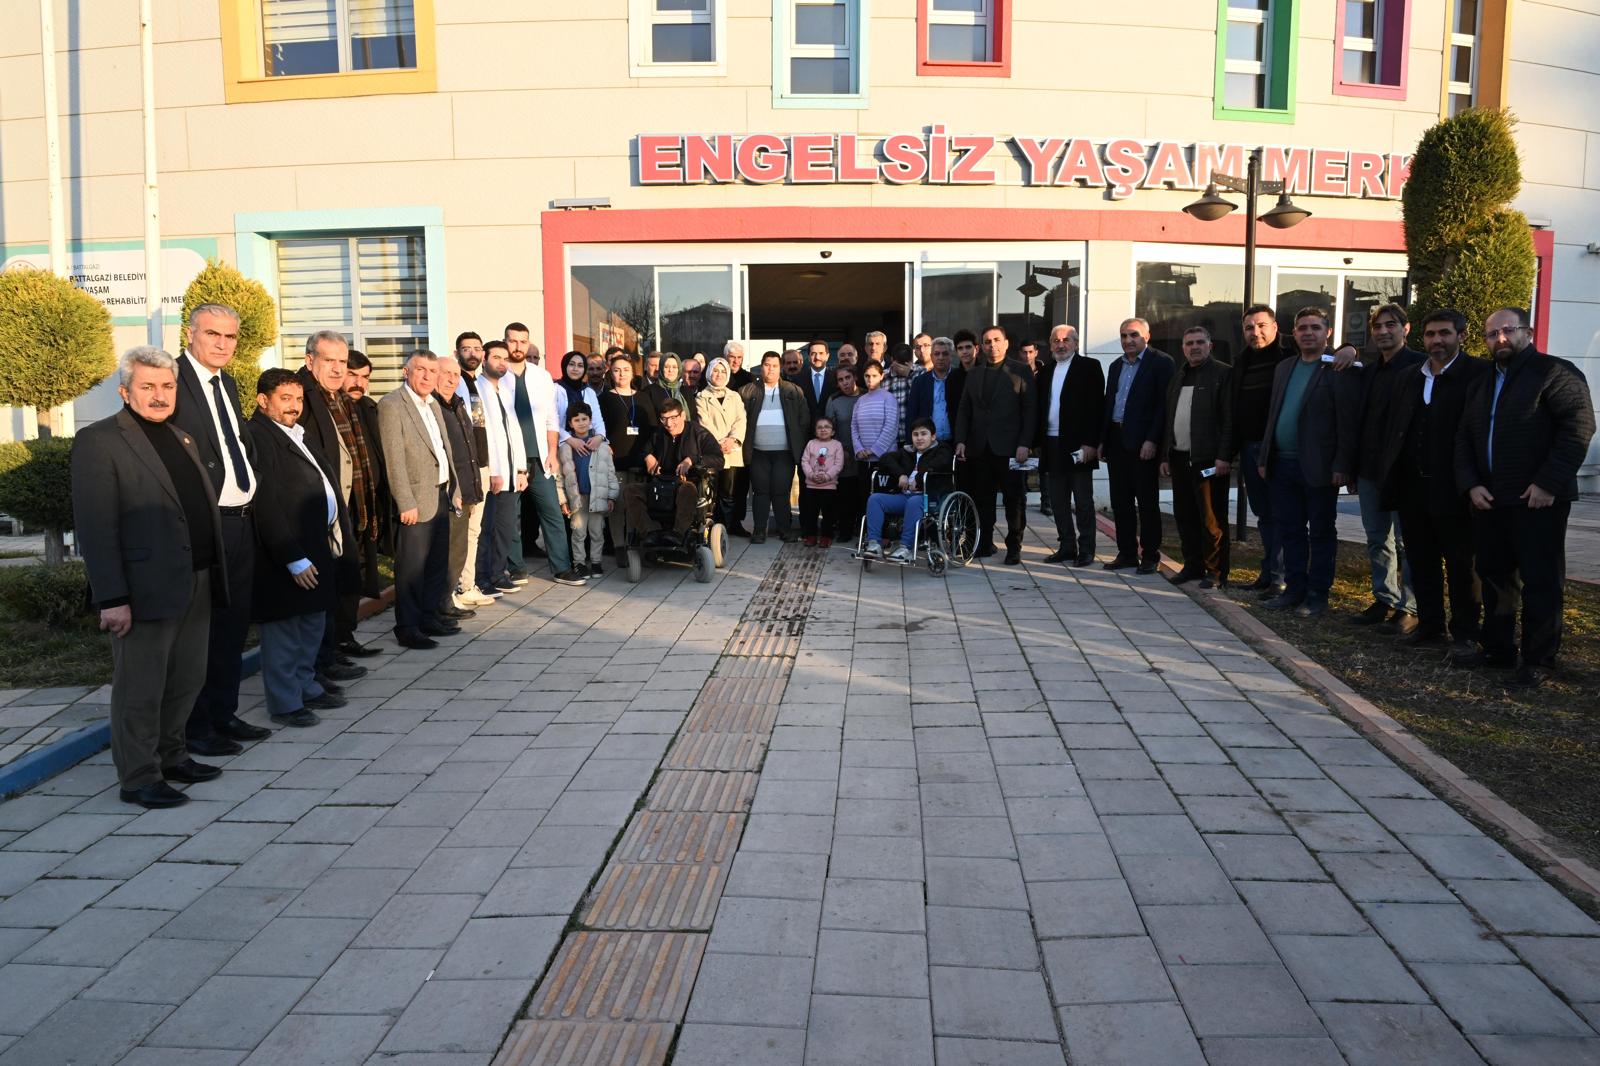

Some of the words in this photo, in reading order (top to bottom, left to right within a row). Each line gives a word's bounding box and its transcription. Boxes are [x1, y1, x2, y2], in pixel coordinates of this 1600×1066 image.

[637, 123, 996, 185] ENGELSİZ
[1014, 135, 1246, 198] YAŞAM
[69, 273, 112, 282] BATTALGAZİ
[85, 286, 110, 295] YAŞAM
[878, 474, 890, 487] W
